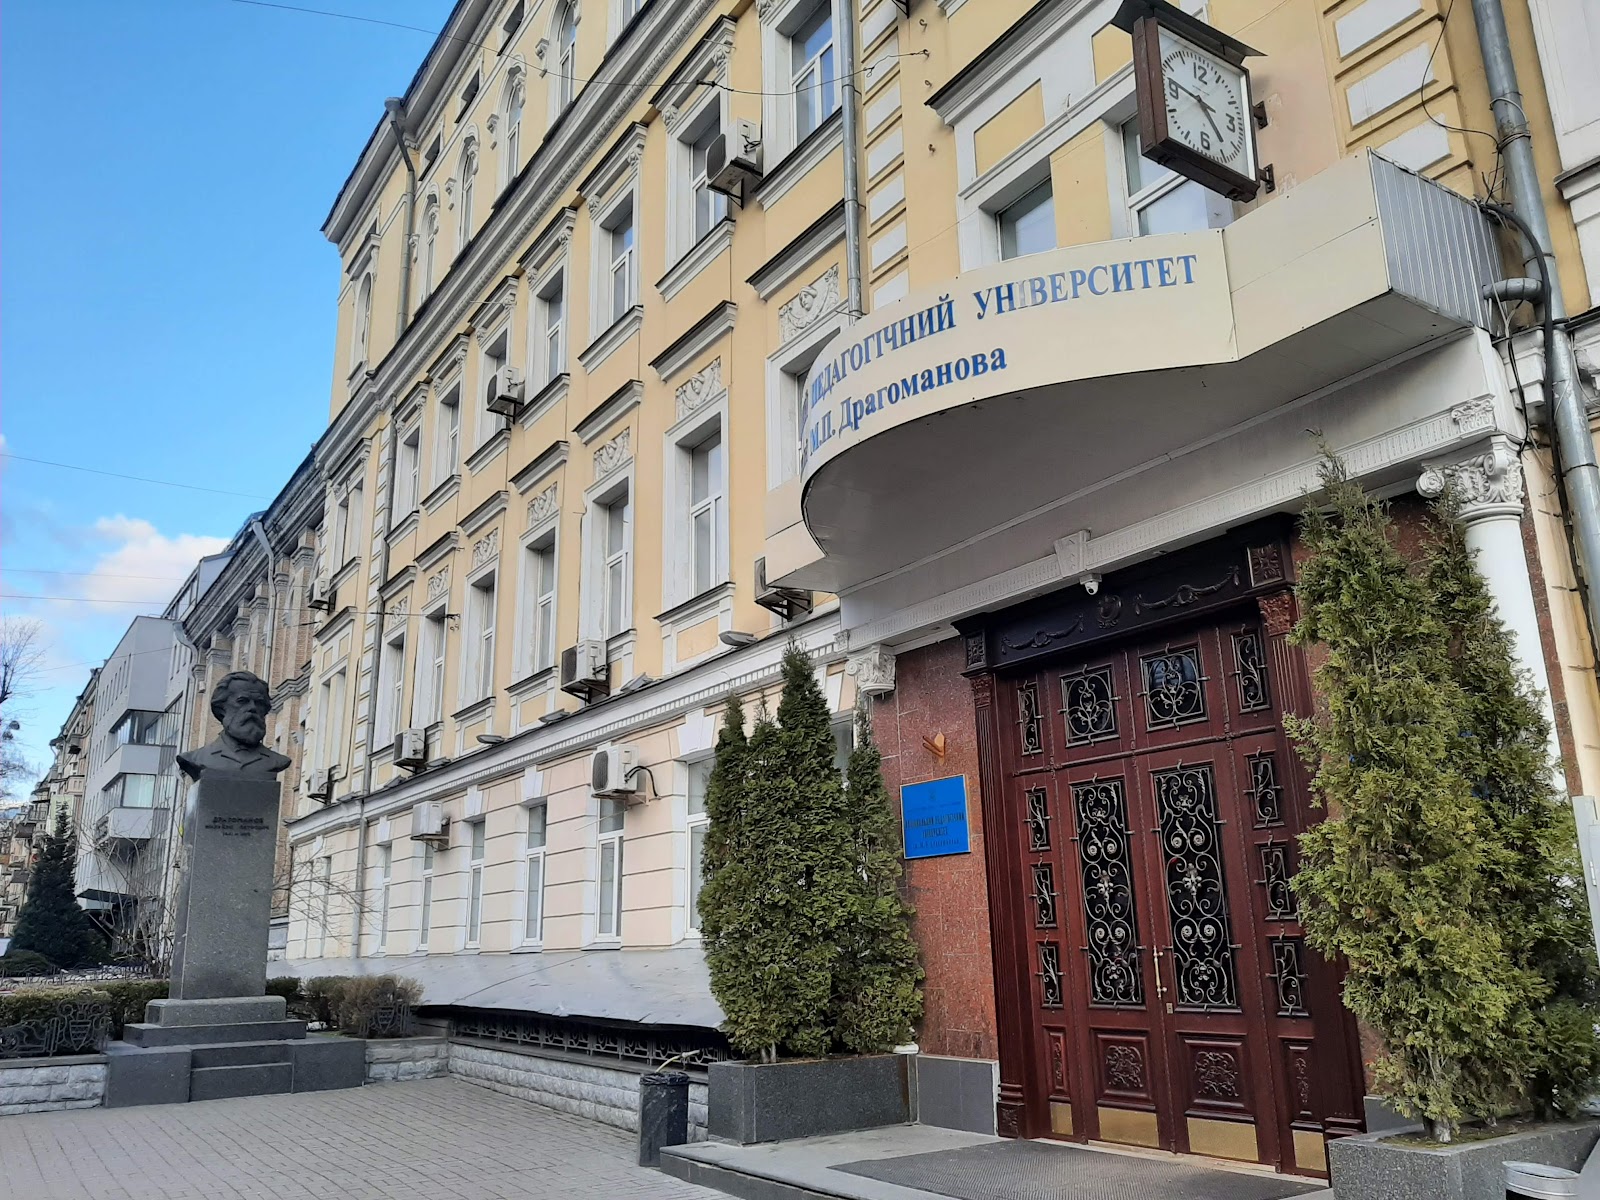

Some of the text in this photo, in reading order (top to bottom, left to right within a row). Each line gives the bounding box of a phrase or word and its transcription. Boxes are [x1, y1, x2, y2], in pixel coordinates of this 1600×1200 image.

[1193, 62, 1208, 85] 12
[1168, 80, 1179, 100] 9
[1225, 113, 1236, 133] 3
[1200, 130, 1211, 151] 6
[811, 254, 1198, 410] ПЕДАГОГІЧНИЙ УНІВЕРСИТЕТ
[839, 347, 1008, 439] Драгоманова
